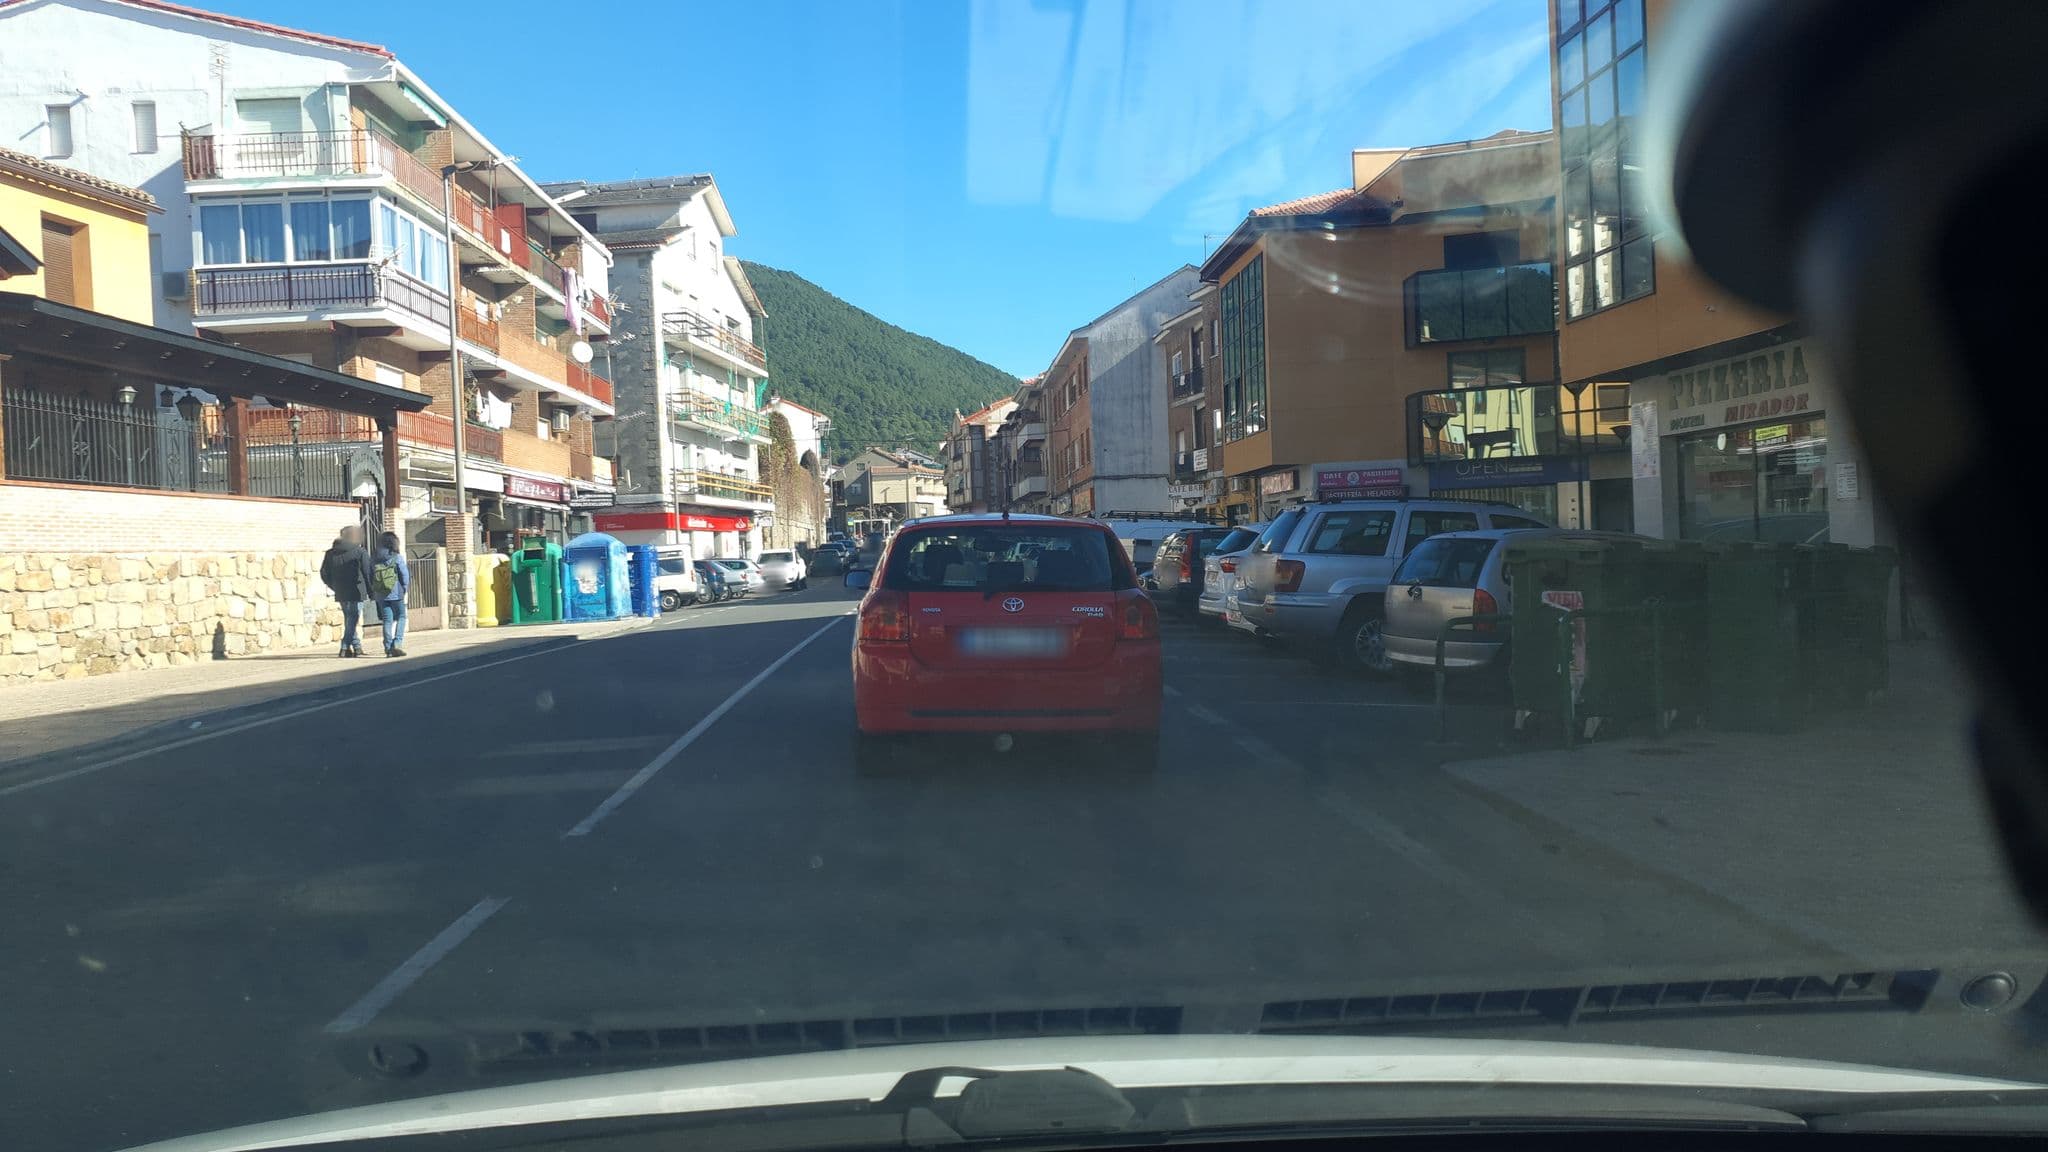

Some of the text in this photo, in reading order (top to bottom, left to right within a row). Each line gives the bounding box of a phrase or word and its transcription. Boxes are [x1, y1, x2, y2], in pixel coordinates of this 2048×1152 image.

[1668, 346, 1809, 411] PIZZERIA
[1725, 393, 1809, 423] MIRADOR
[1455, 462, 1509, 475] OPEN
